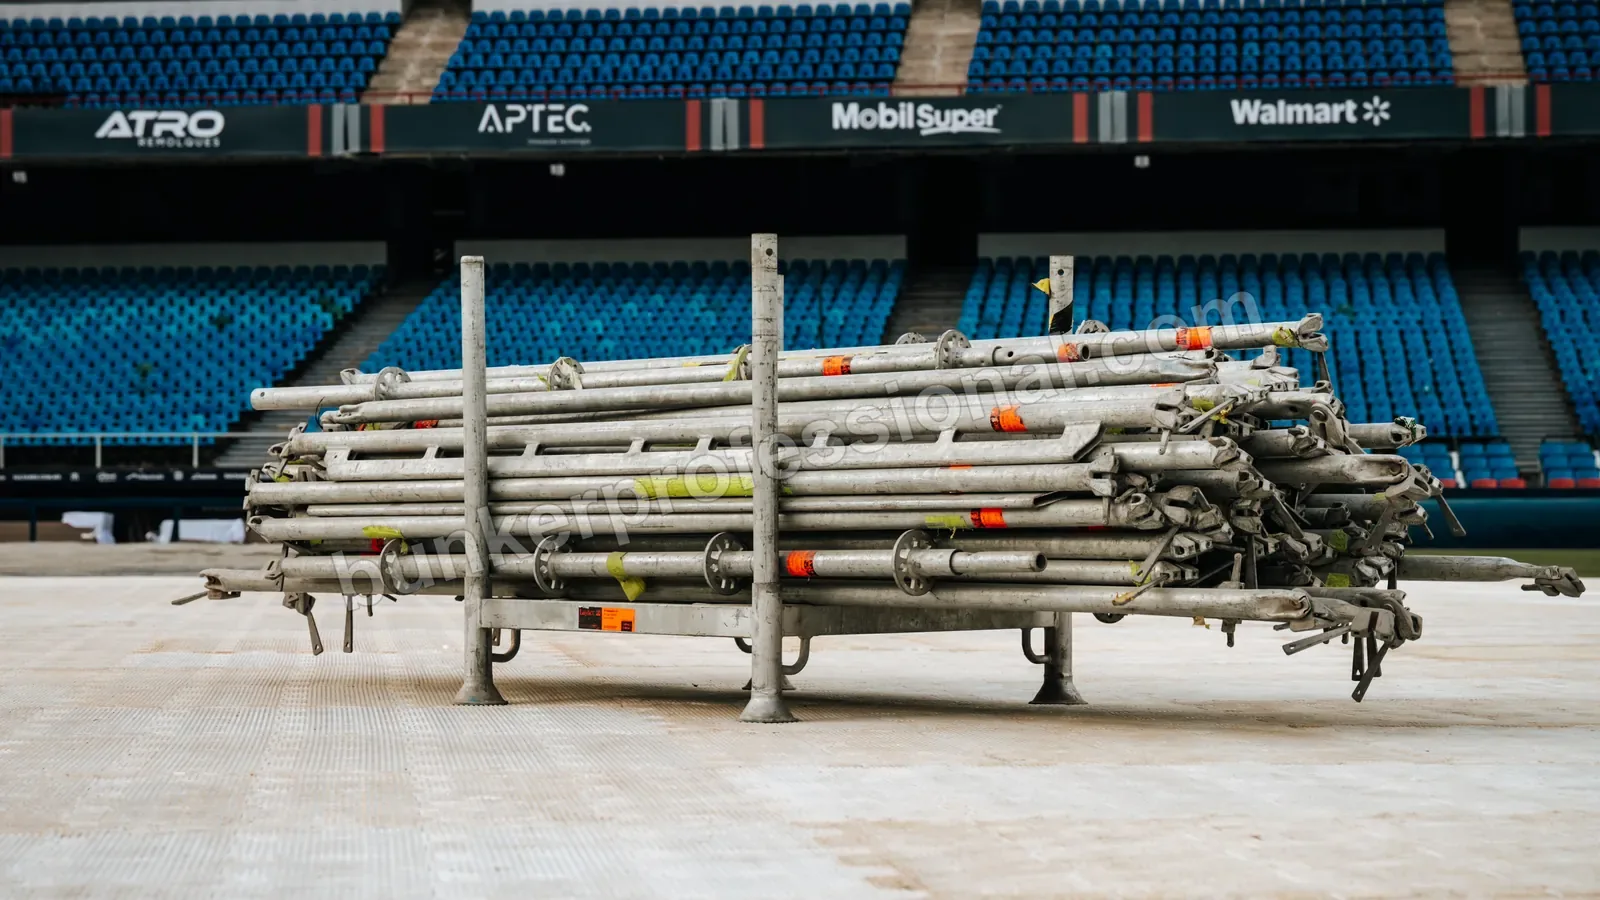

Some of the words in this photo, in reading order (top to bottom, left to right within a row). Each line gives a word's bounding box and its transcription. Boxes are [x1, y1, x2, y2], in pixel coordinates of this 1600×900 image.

[95, 110, 225, 138] ATRO
[478, 103, 592, 133] APTEC
[1230, 99, 1358, 125] Walmart
[137, 137, 220, 147] REMOLQUES
